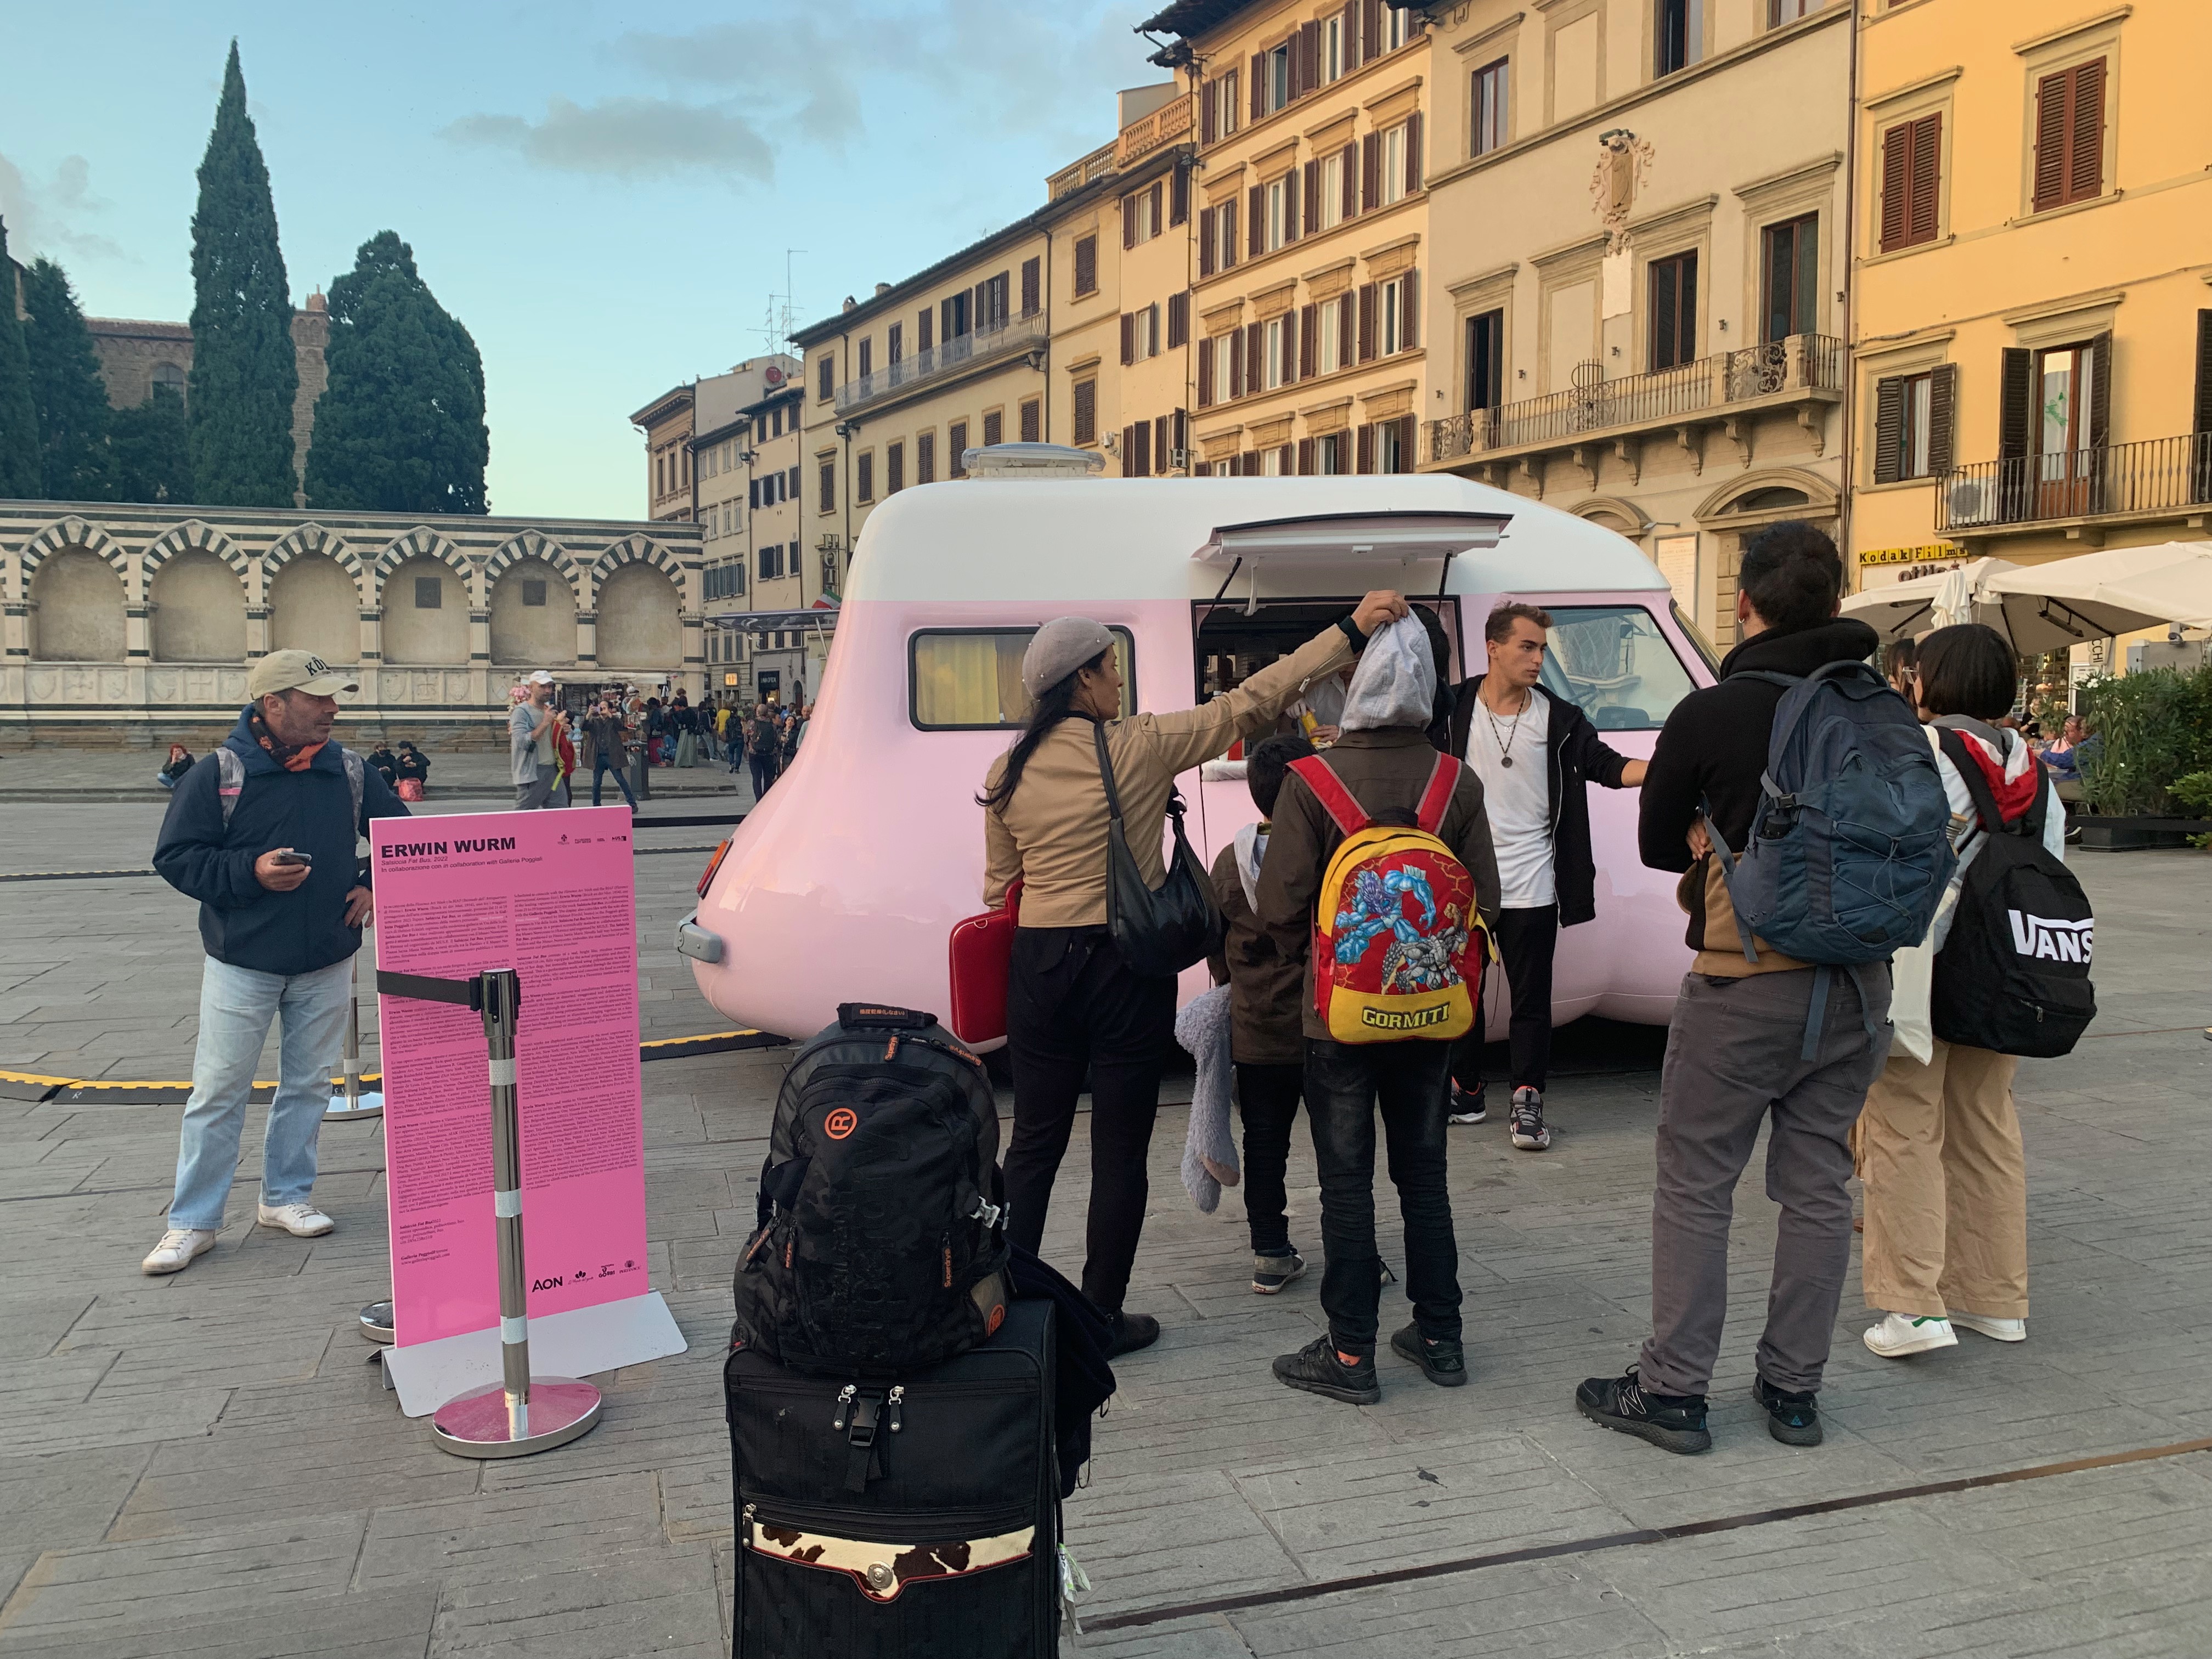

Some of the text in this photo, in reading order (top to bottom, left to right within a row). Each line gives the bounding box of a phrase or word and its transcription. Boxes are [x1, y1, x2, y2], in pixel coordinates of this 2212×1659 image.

[823, 534, 839, 593] HOT
[1860, 546, 1966, 563] Kodak Films
[2092, 639, 2103, 663] CCHI
[381, 837, 516, 857] ERWIN WURM
[388, 864, 430, 872] collaborazione
[2008, 909, 2095, 964] VANS
[1362, 1003, 1449, 1029] GORMITI
[532, 1276, 563, 1293] AON
